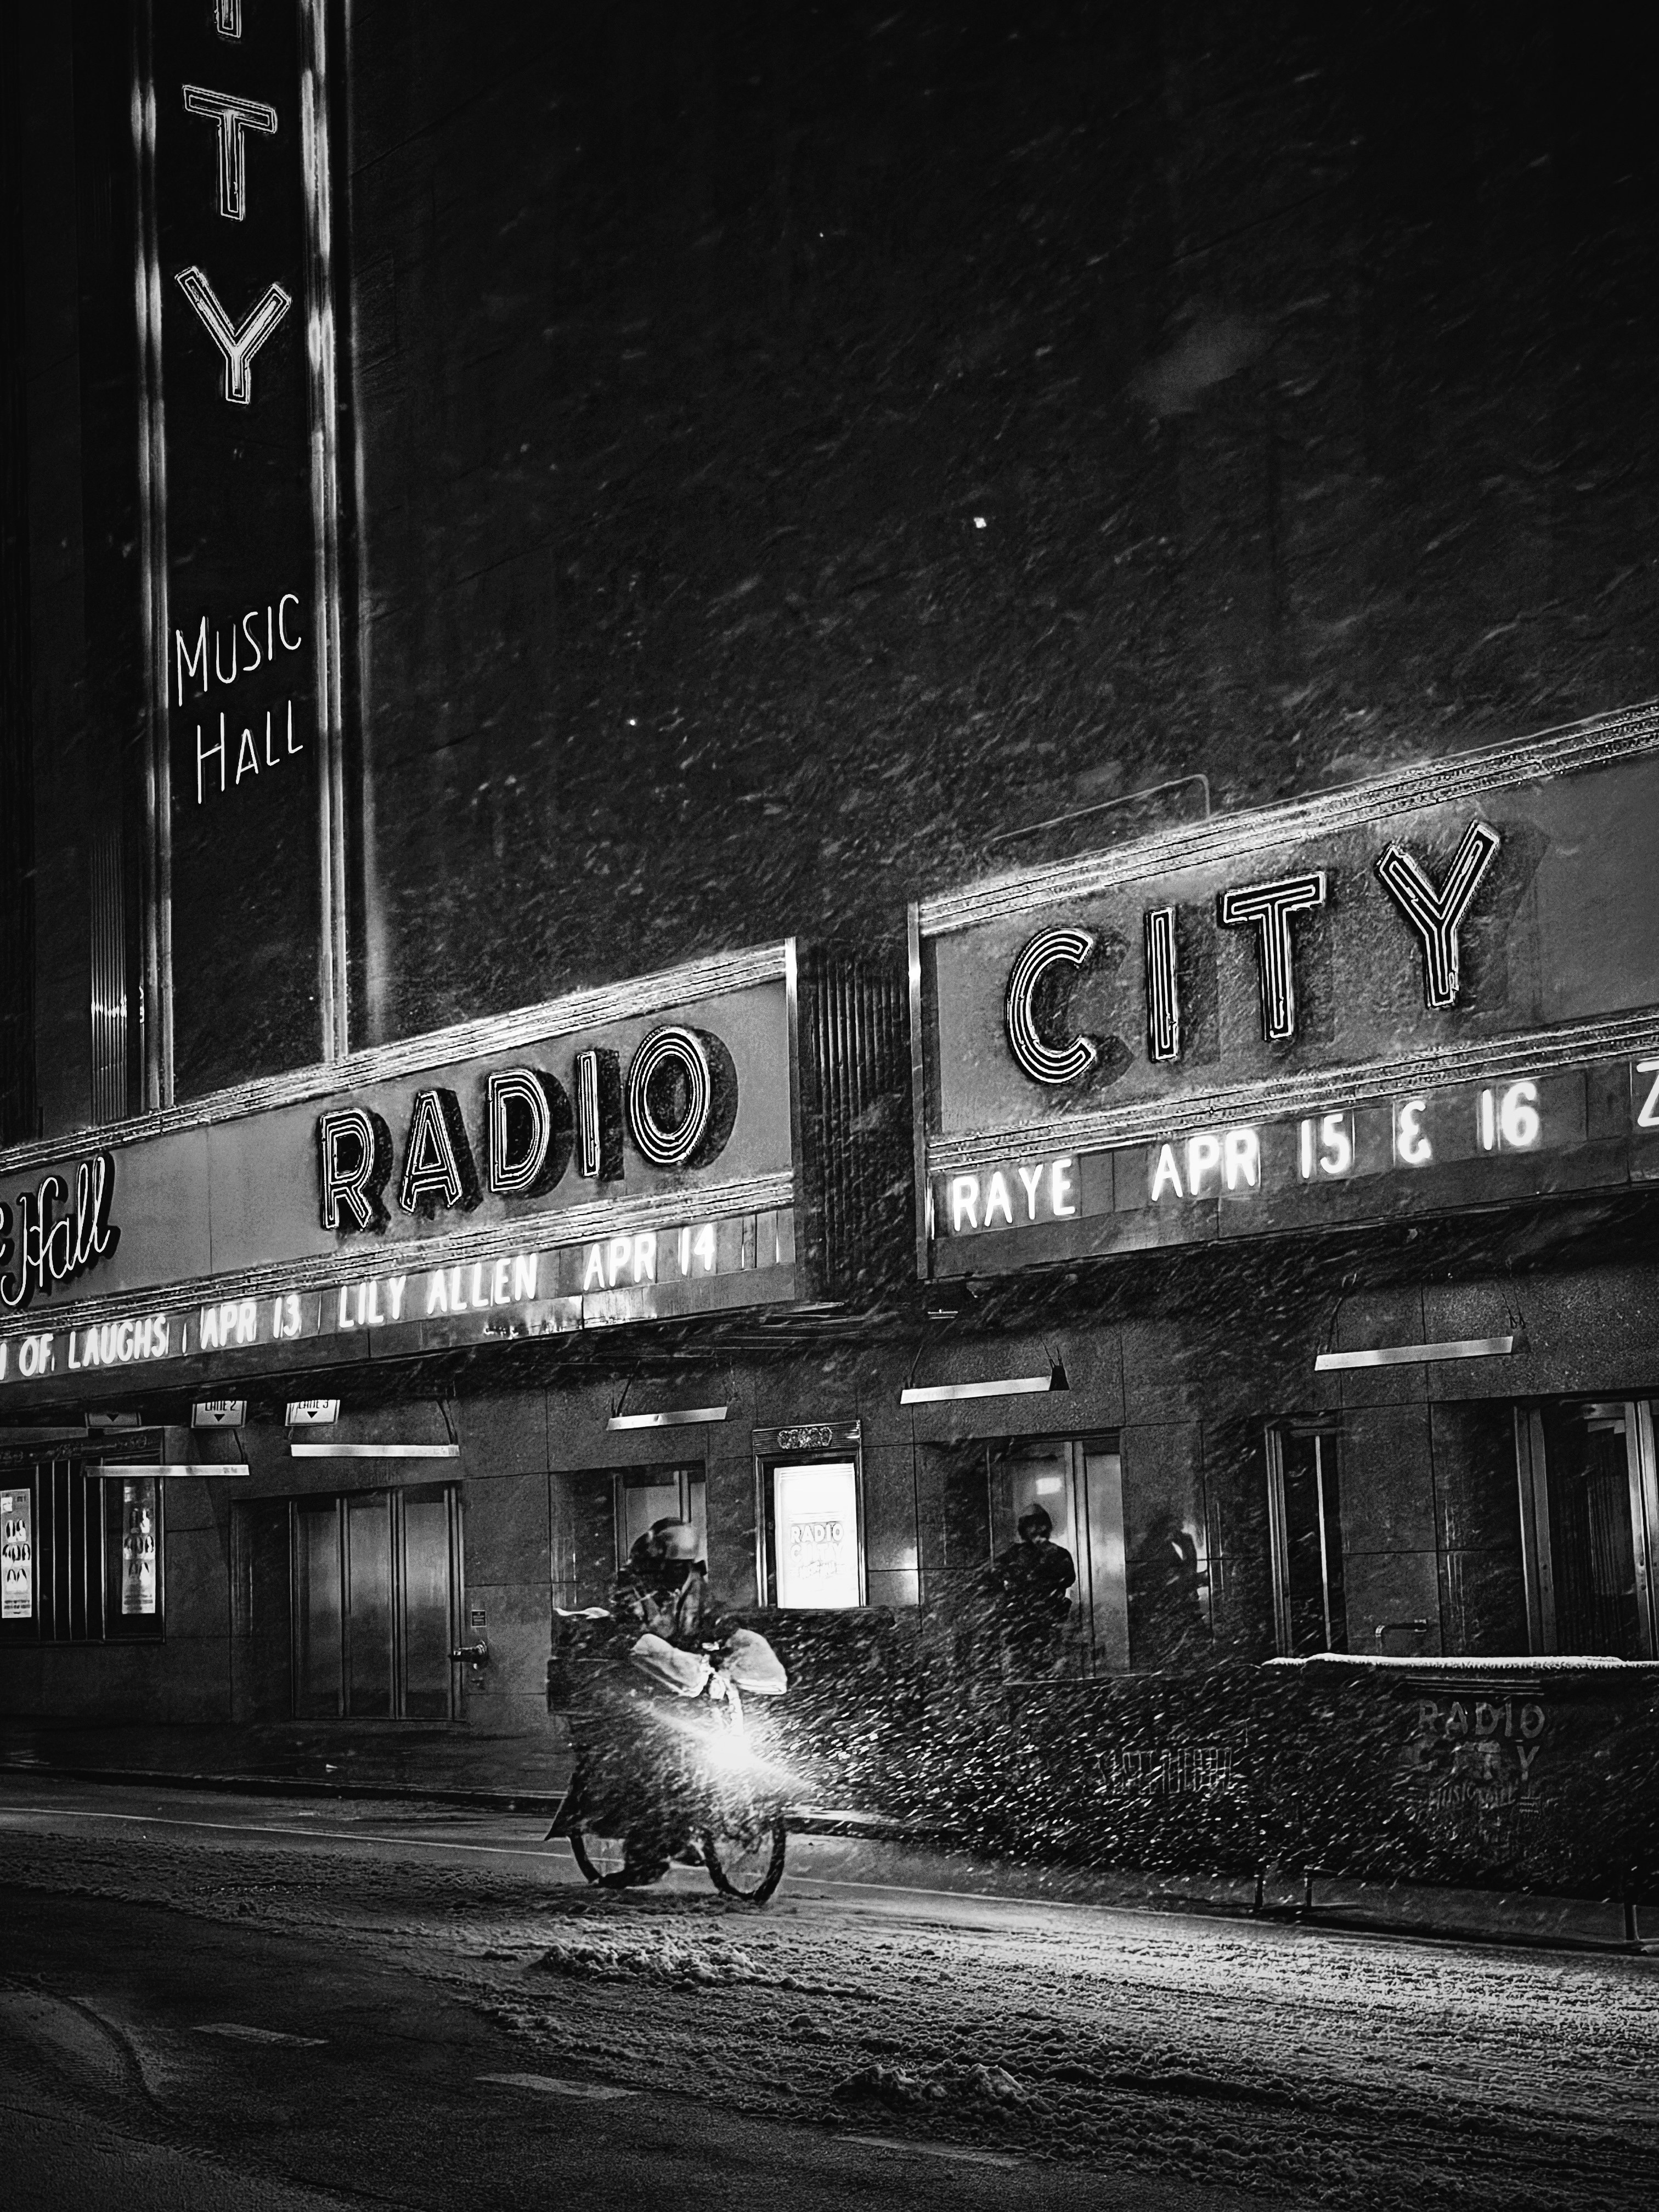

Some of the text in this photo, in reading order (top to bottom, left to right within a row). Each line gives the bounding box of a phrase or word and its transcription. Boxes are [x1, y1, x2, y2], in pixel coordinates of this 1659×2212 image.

[176, 593, 302, 707] MUSIC
[196, 699, 303, 804] HALL
[1005, 820, 1500, 1085] CITY
[319, 1025, 712, 1232] RADIO
[952, 1158, 1075, 1232] RAYE
[1152, 1128, 1260, 1202] APR
[1300, 1113, 1353, 1179] 15
[1482, 1082, 1540, 1151] 16
[1, 1156, 111, 1306] Hall
[19, 1333, 54, 1376] OF
[68, 1316, 167, 1369] LAUGHS
[201, 1302, 256, 1350] APR
[274, 1294, 300, 1339] 13
[339, 1276, 407, 1328] LILY
[427, 1253, 537, 1315] ALLEN
[583, 1233, 657, 1291] APR
[680, 1223, 715, 1276] 14
[791, 1523, 844, 1543] RADIO
[1418, 1699, 1545, 1739] RADIO
